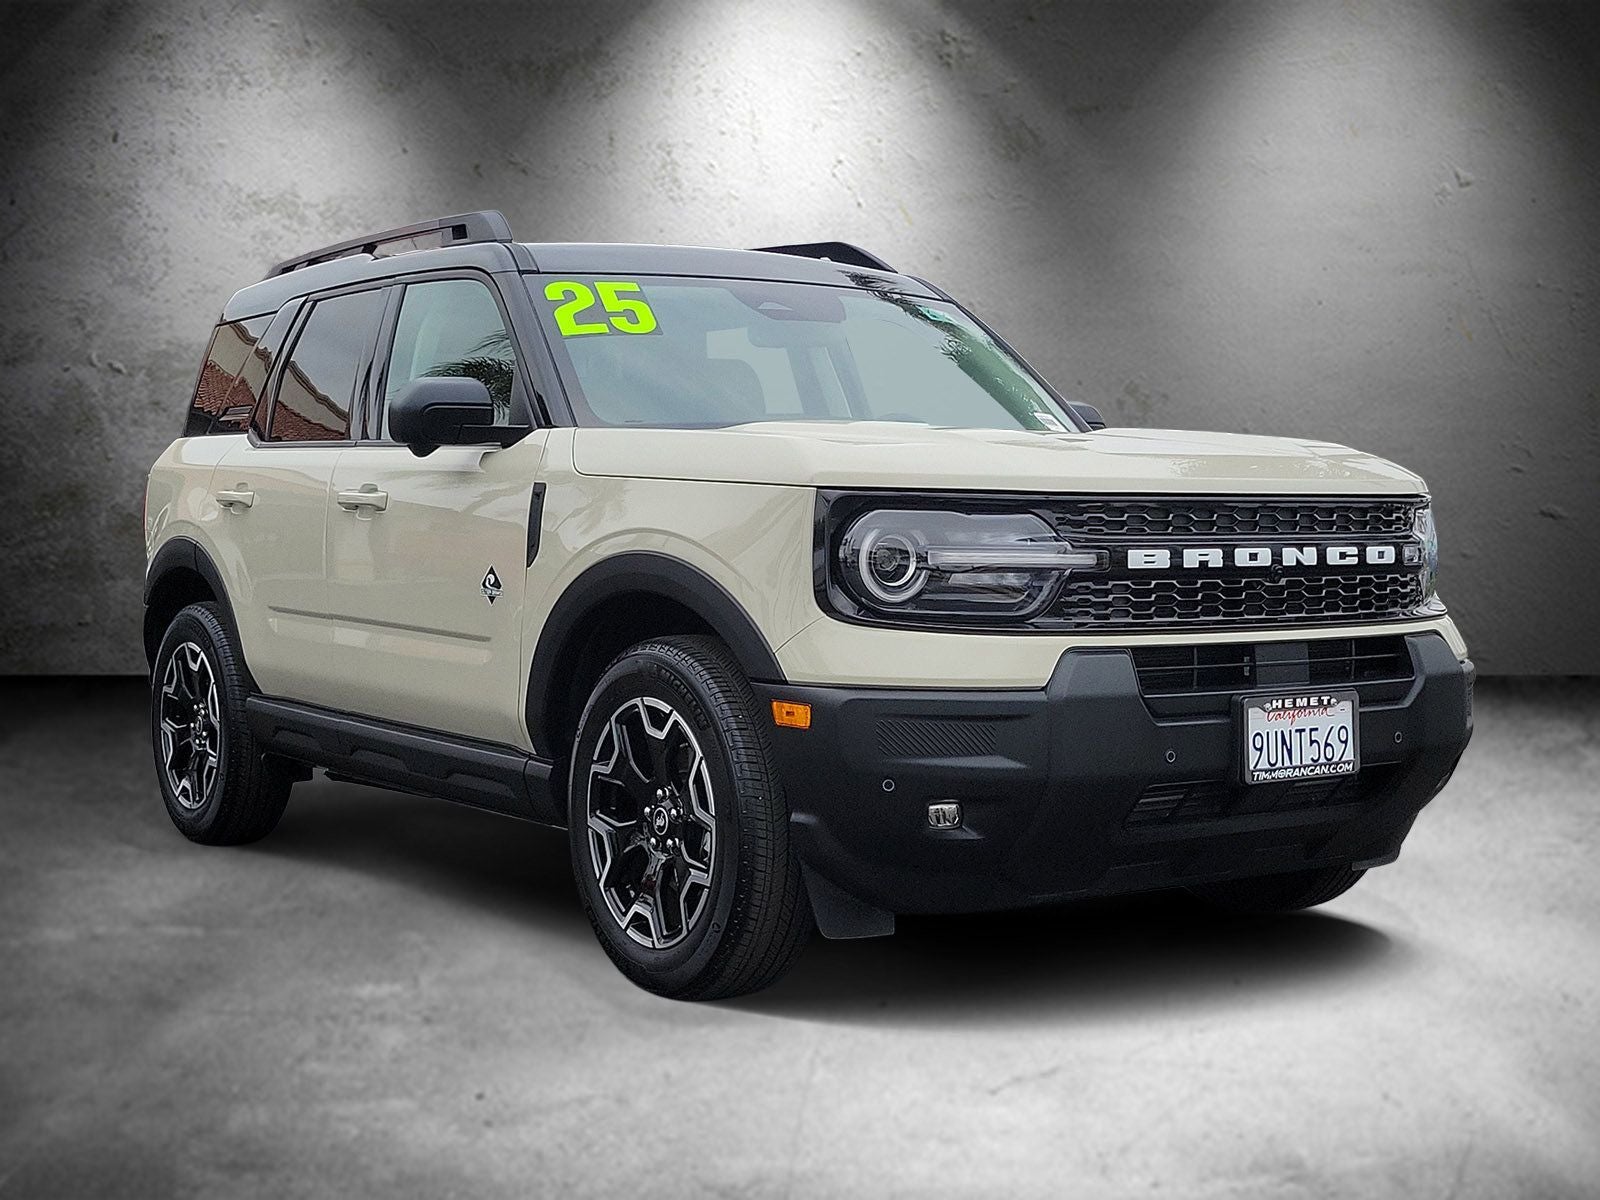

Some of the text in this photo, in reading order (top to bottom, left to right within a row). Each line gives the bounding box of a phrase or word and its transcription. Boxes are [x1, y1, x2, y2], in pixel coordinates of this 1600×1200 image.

[544, 281, 657, 336] 25
[1127, 546, 1396, 569] BRONCO
[1271, 696, 1331, 709] HEMET
[1266, 707, 1335, 725] California
[1252, 725, 1349, 769] 9UNT569
[1252, 762, 1354, 781] TIMMORANCAN.COM
